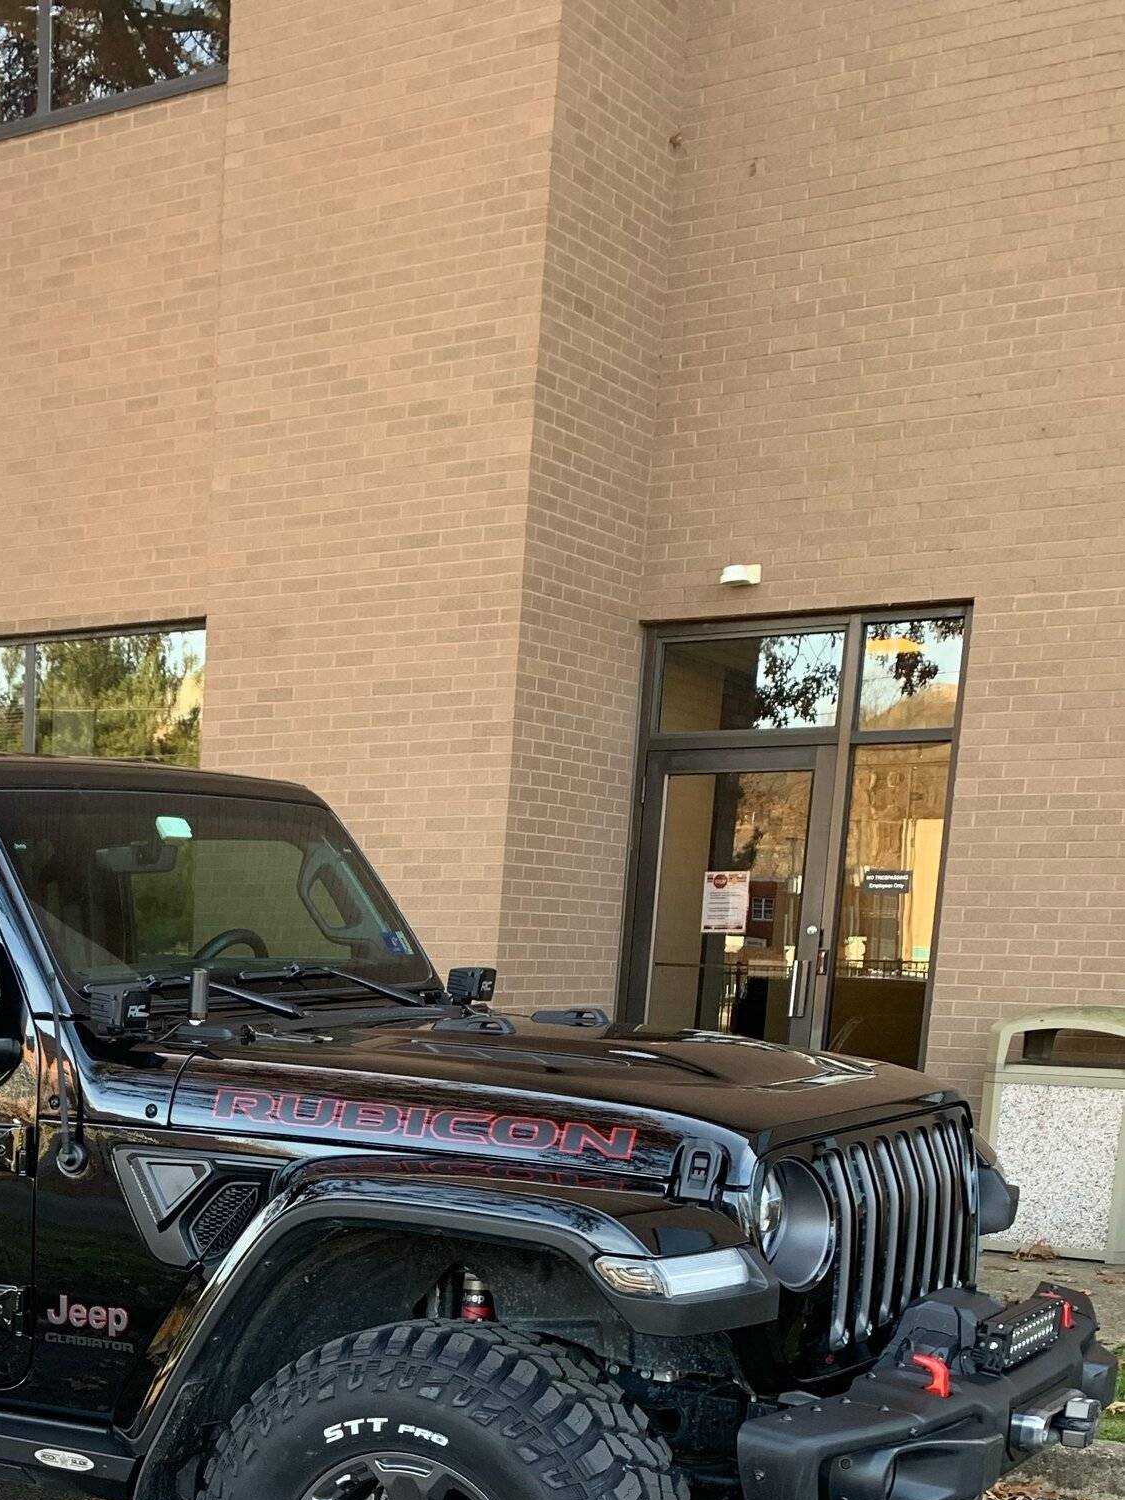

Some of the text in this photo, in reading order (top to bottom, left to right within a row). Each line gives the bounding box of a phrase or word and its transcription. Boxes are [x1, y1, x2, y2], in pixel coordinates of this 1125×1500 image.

[212, 1088, 638, 1160] RUBICON
[46, 1294, 128, 1337] Jeep
[44, 1332, 135, 1354] GLADIATOR
[323, 1417, 449, 1447] STT PRO
